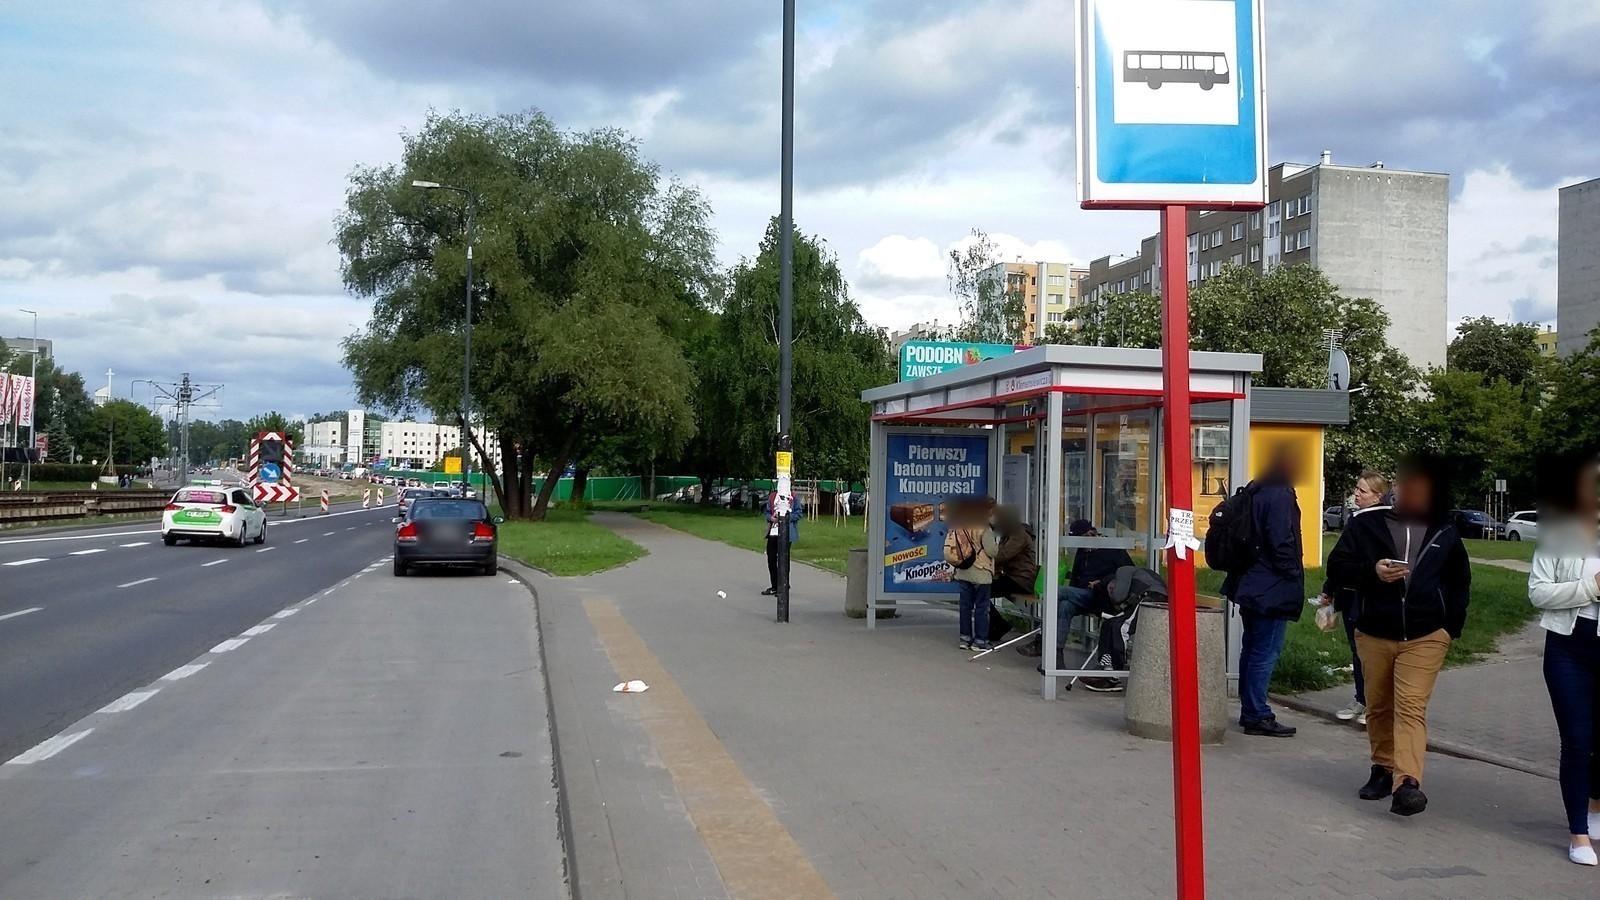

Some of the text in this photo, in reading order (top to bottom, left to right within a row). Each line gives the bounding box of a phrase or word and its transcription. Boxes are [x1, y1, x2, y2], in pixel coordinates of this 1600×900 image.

[906, 345, 963, 364] PODOBN
[908, 444, 967, 462] Pierwszy
[893, 461, 981, 478] baton w stylu
[899, 478, 975, 495] Knoppersa!
[892, 547, 924, 562] NOWOŚĆ
[905, 562, 951, 580] Knoppers
